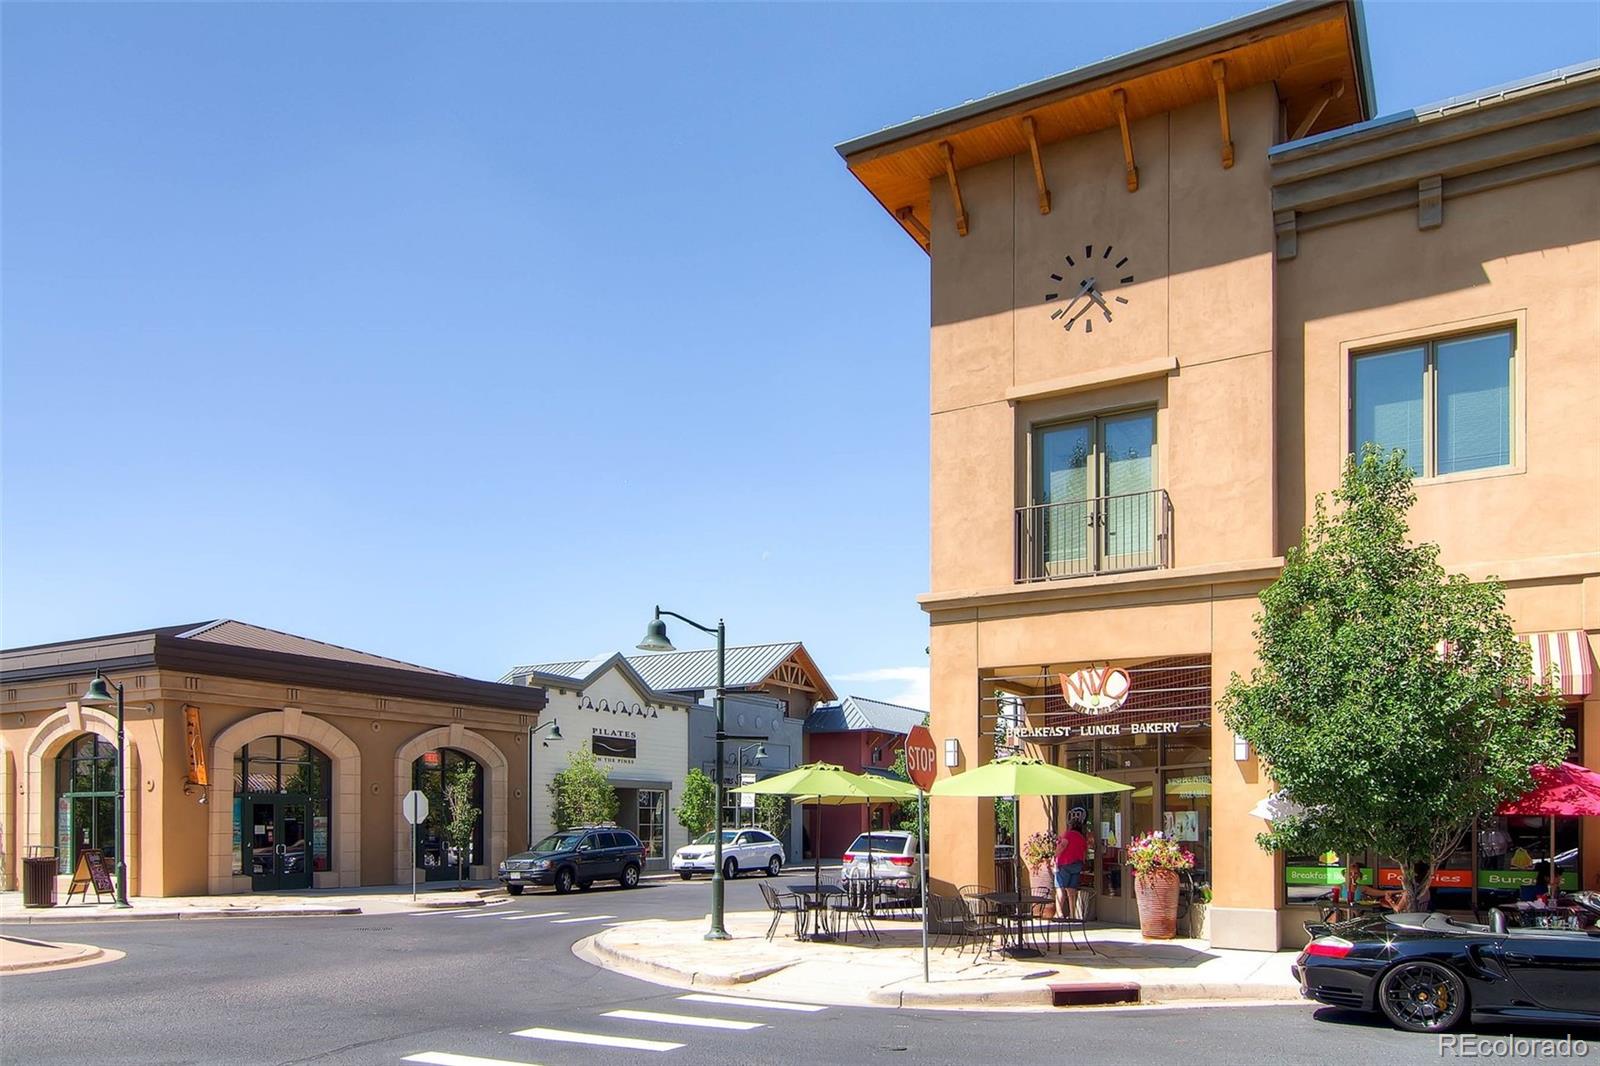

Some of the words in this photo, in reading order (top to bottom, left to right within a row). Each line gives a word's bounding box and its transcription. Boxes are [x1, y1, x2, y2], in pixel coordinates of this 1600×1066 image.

[592, 727, 637, 739] PILATES
[1006, 726, 1071, 738] BREAKFAST
[1080, 724, 1120, 736] LUNCH
[1130, 722, 1180, 734] BAKERY
[908, 745, 935, 772] STOP
[1387, 872, 1461, 883] Paries
[1489, 874, 1565, 886] Burgs
